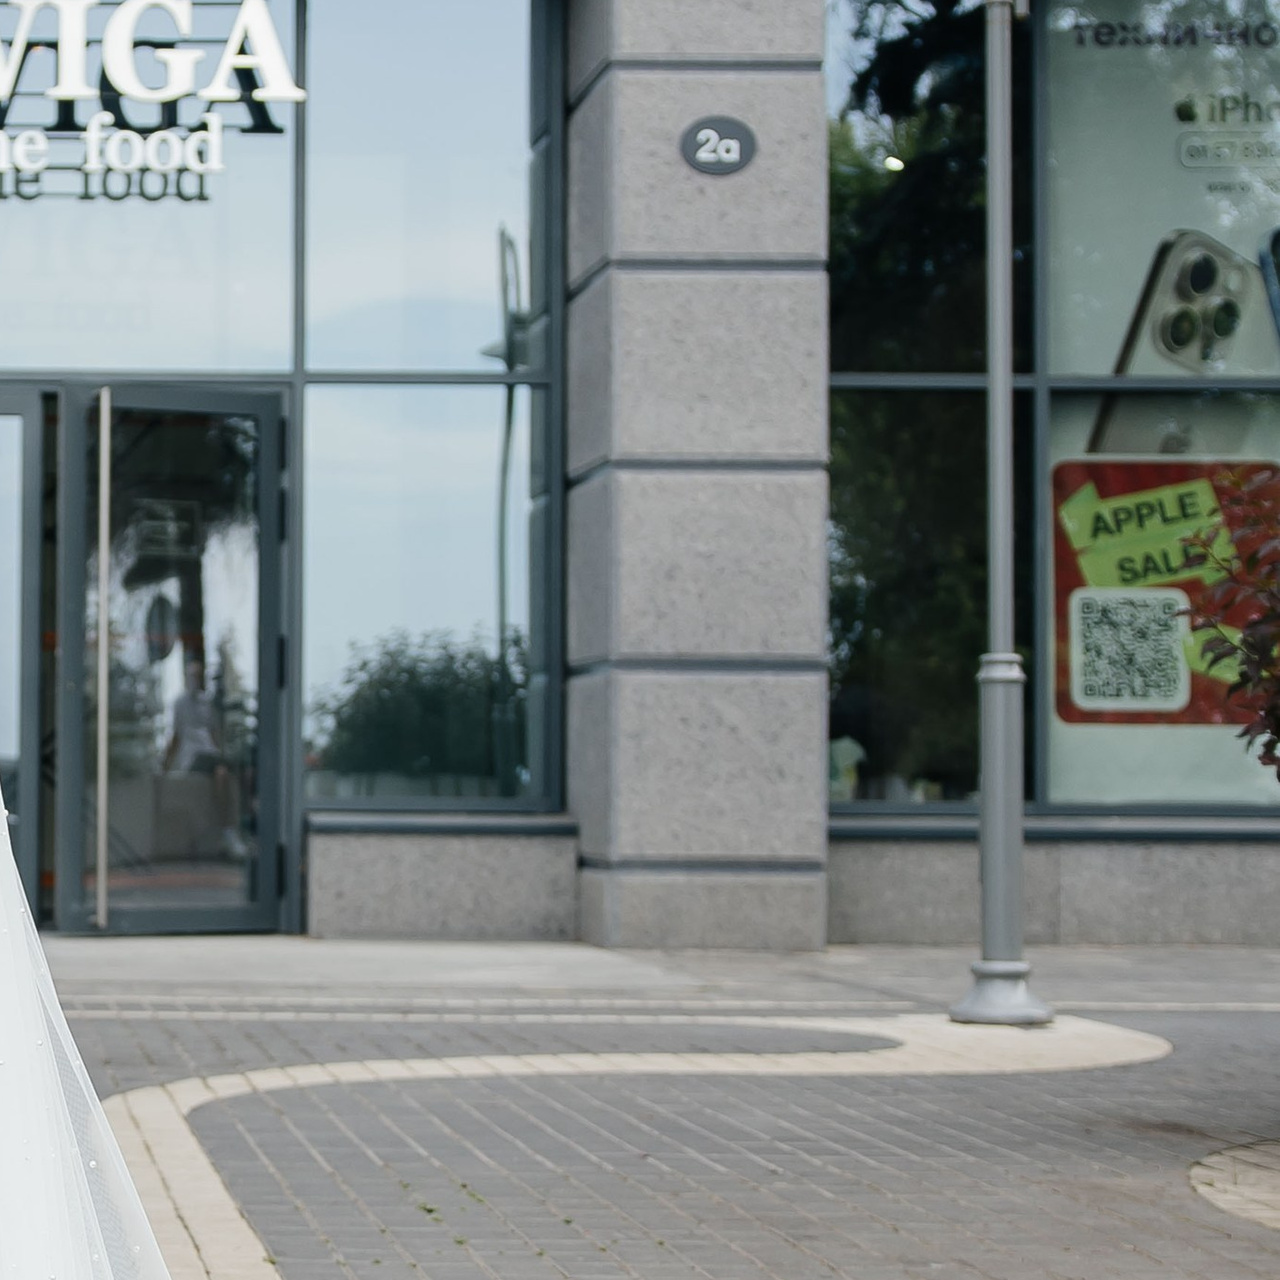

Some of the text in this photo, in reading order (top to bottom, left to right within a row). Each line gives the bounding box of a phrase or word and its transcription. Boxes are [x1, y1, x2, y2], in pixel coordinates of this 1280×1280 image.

[80, 111, 225, 173] food
[695, 128, 741, 163] 2а
[1090, 491, 1201, 539] APPLE
